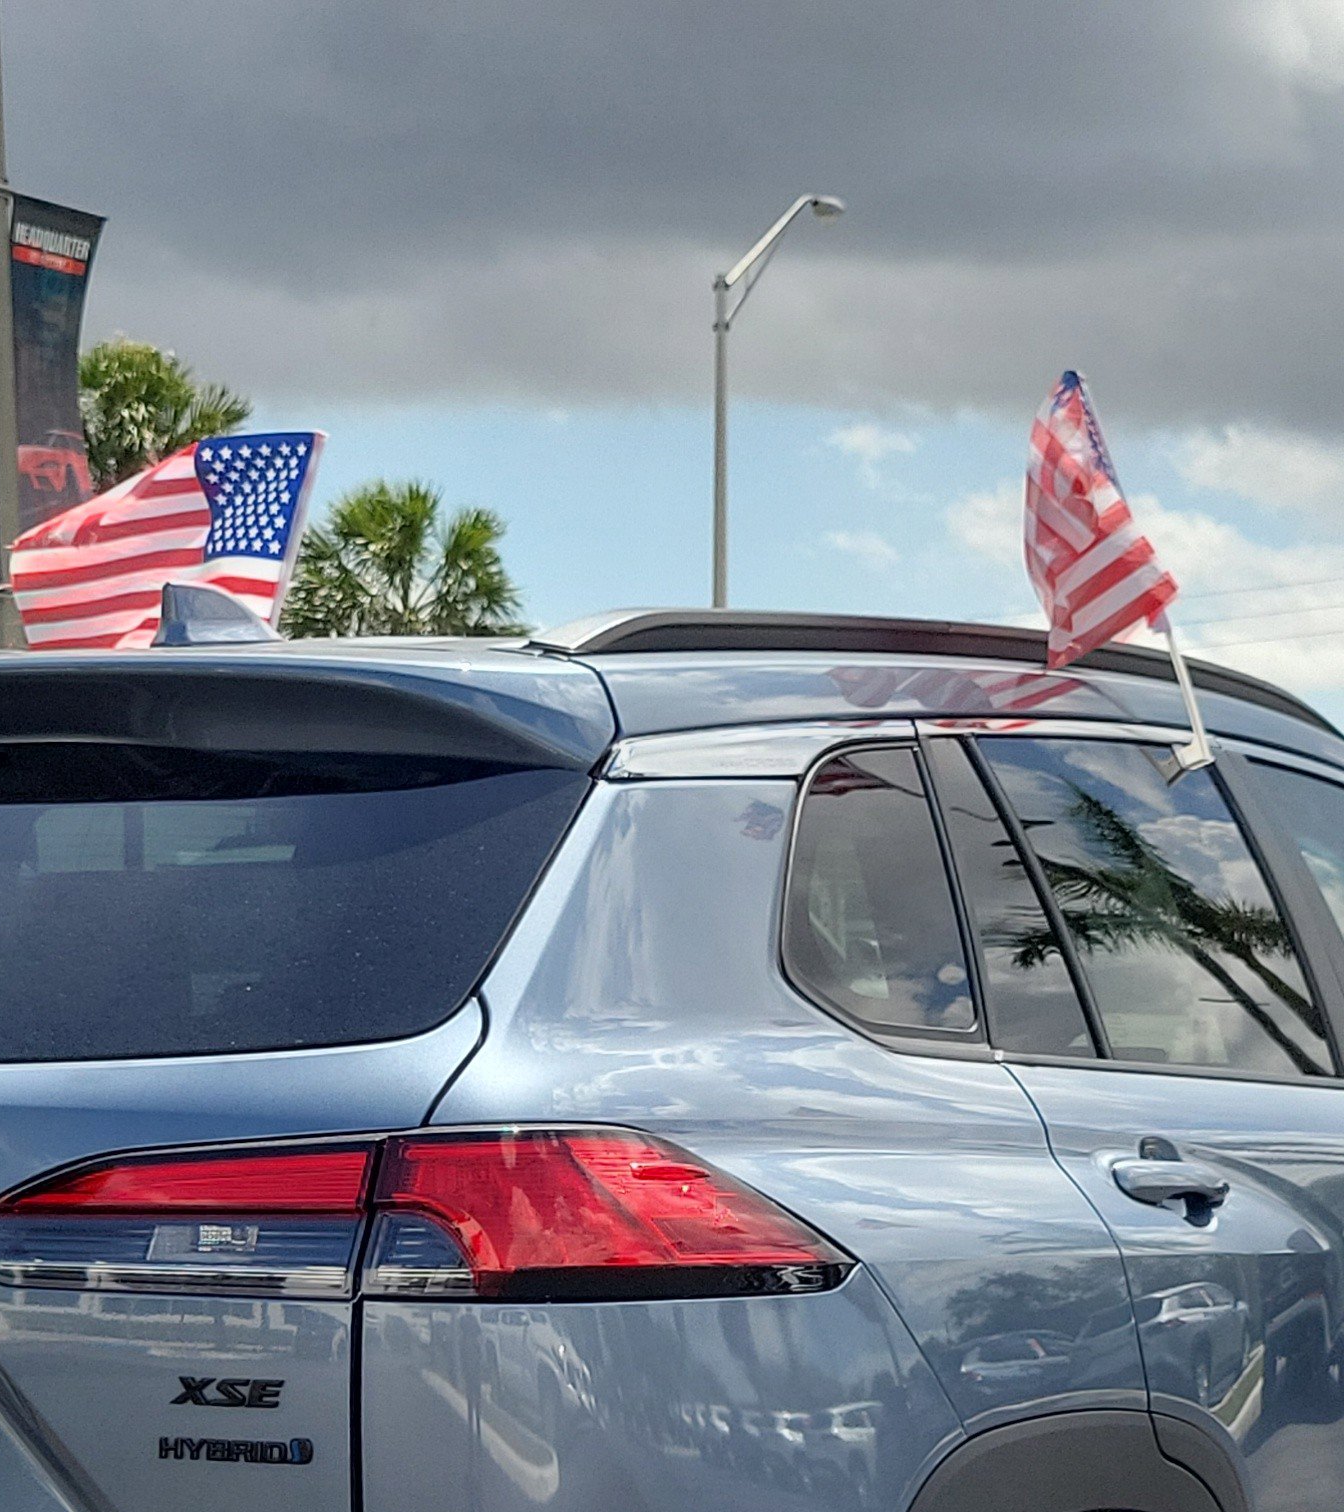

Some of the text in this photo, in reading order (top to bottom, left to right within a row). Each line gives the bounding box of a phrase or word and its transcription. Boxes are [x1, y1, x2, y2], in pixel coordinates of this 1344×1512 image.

[15, 222, 90, 260] HEADQUARTER
[169, 1376, 285, 1408] XSE
[158, 1437, 288, 1463] HYBRID
